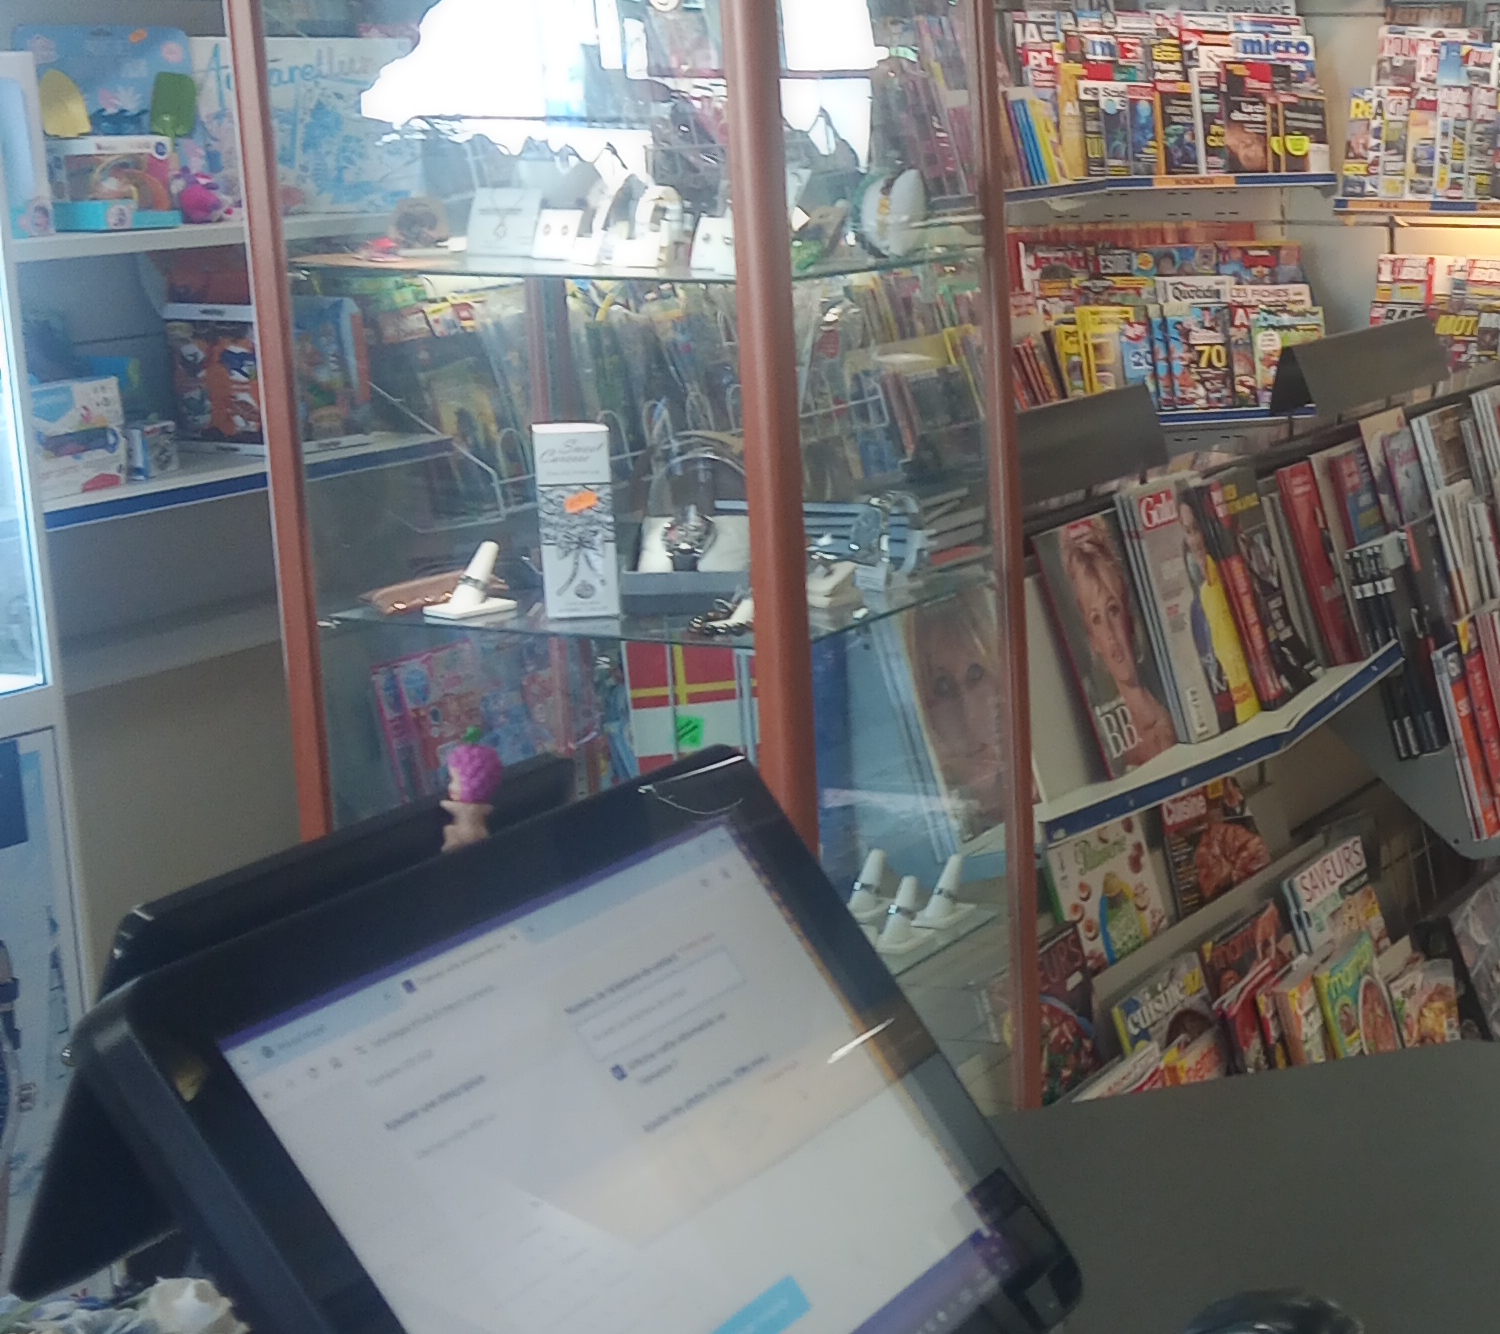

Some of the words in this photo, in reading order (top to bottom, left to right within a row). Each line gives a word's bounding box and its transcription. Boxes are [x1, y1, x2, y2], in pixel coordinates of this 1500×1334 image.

[1241, 33, 1311, 57] micro
[1195, 344, 1228, 368] 70
[1300, 838, 1365, 903] SAVEURS
